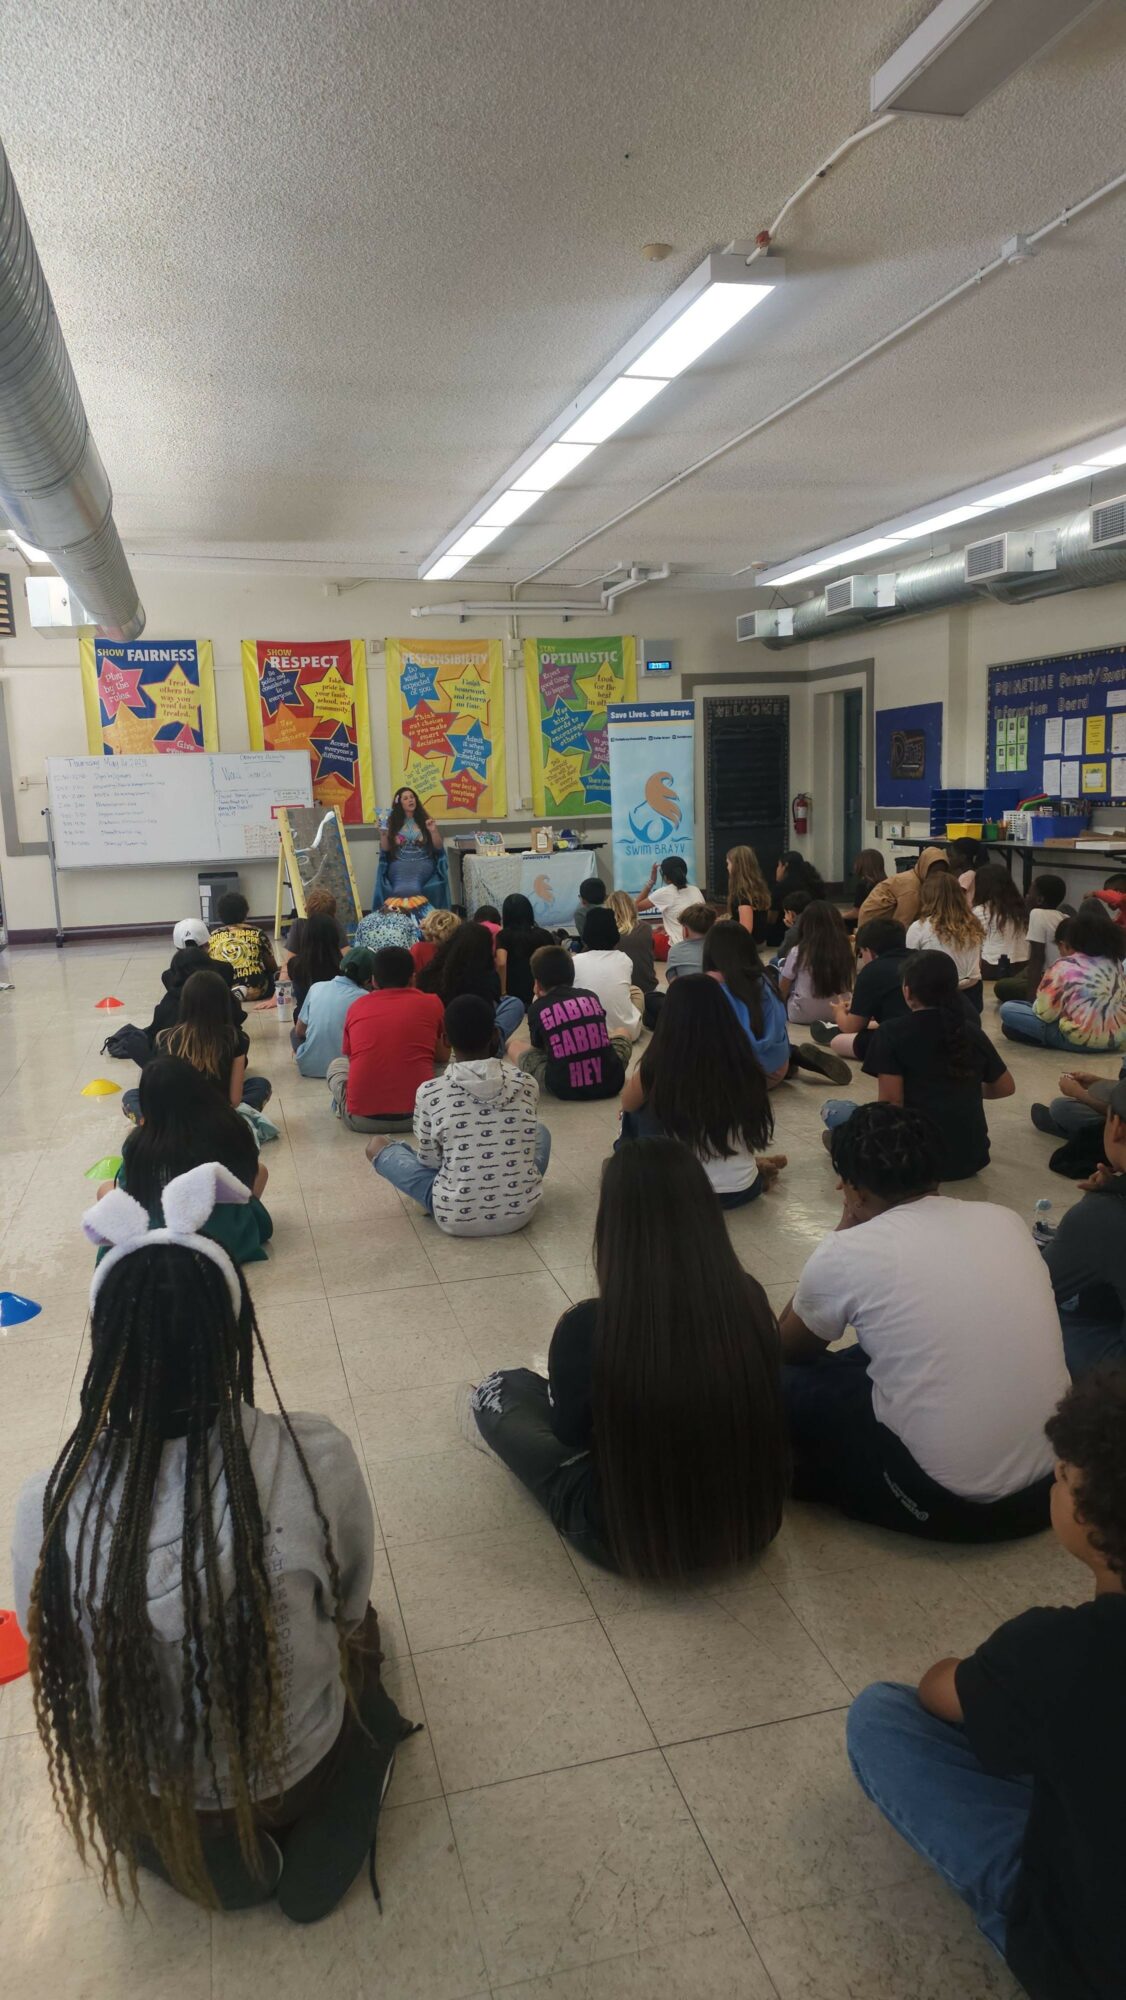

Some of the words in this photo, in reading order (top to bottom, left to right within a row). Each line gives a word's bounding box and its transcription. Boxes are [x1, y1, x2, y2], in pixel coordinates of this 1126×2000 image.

[127, 649, 195, 661] FAIRNESS
[402, 653, 487, 664] RESPONSIBILITY
[540, 652, 618, 664] OPTIMISTIC
[270, 655, 338, 668] RESPECT
[105, 673, 123, 682] Play
[597, 675, 613, 683] Look
[104, 687, 115, 695] by
[116, 681, 130, 690] the
[1058, 693, 1089, 712] Board
[628, 710, 649, 718] Lives.
[713, 703, 780, 718] WELCOME
[177, 741, 194, 750] Give
[625, 845, 651, 856] SWIM
[655, 843, 685, 854] BRAYV
[235, 930, 260, 938] HAPPY
[540, 996, 604, 1031] GABBA
[549, 1022, 610, 1059] GABBA
[569, 1056, 602, 1088] HEY
